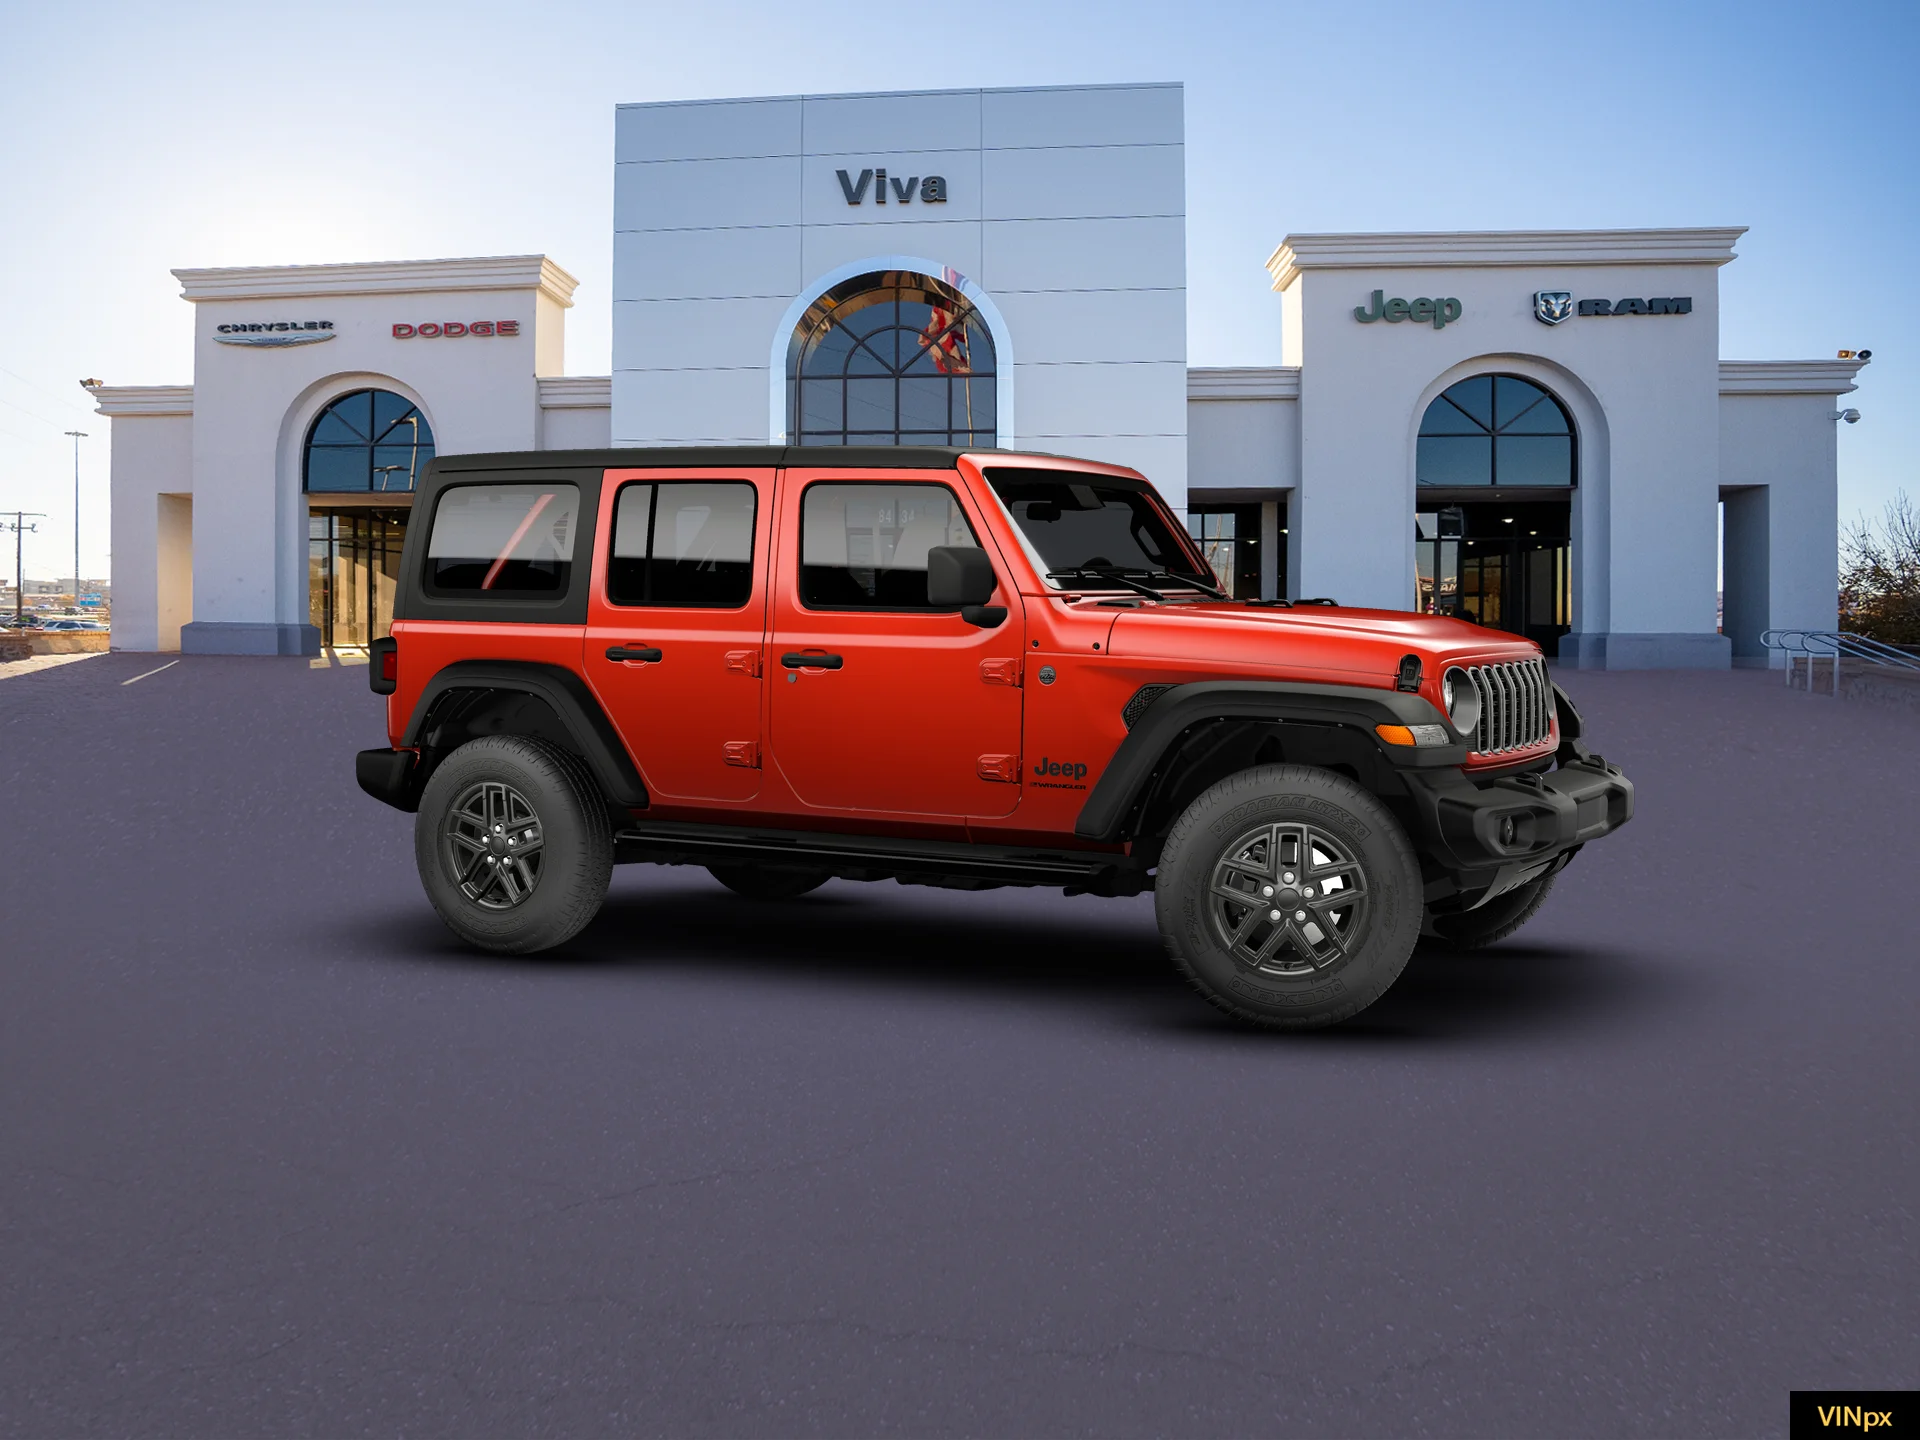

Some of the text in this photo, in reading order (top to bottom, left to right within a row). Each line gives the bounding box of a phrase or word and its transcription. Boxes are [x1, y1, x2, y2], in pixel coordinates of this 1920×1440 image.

[835, 168, 947, 206] Viva
[1353, 289, 1462, 330] Jeep
[1578, 297, 1692, 316] RAM
[217, 321, 333, 333] CHRYSLER
[392, 320, 519, 339] DODGE
[1034, 757, 1087, 780] Jeep
